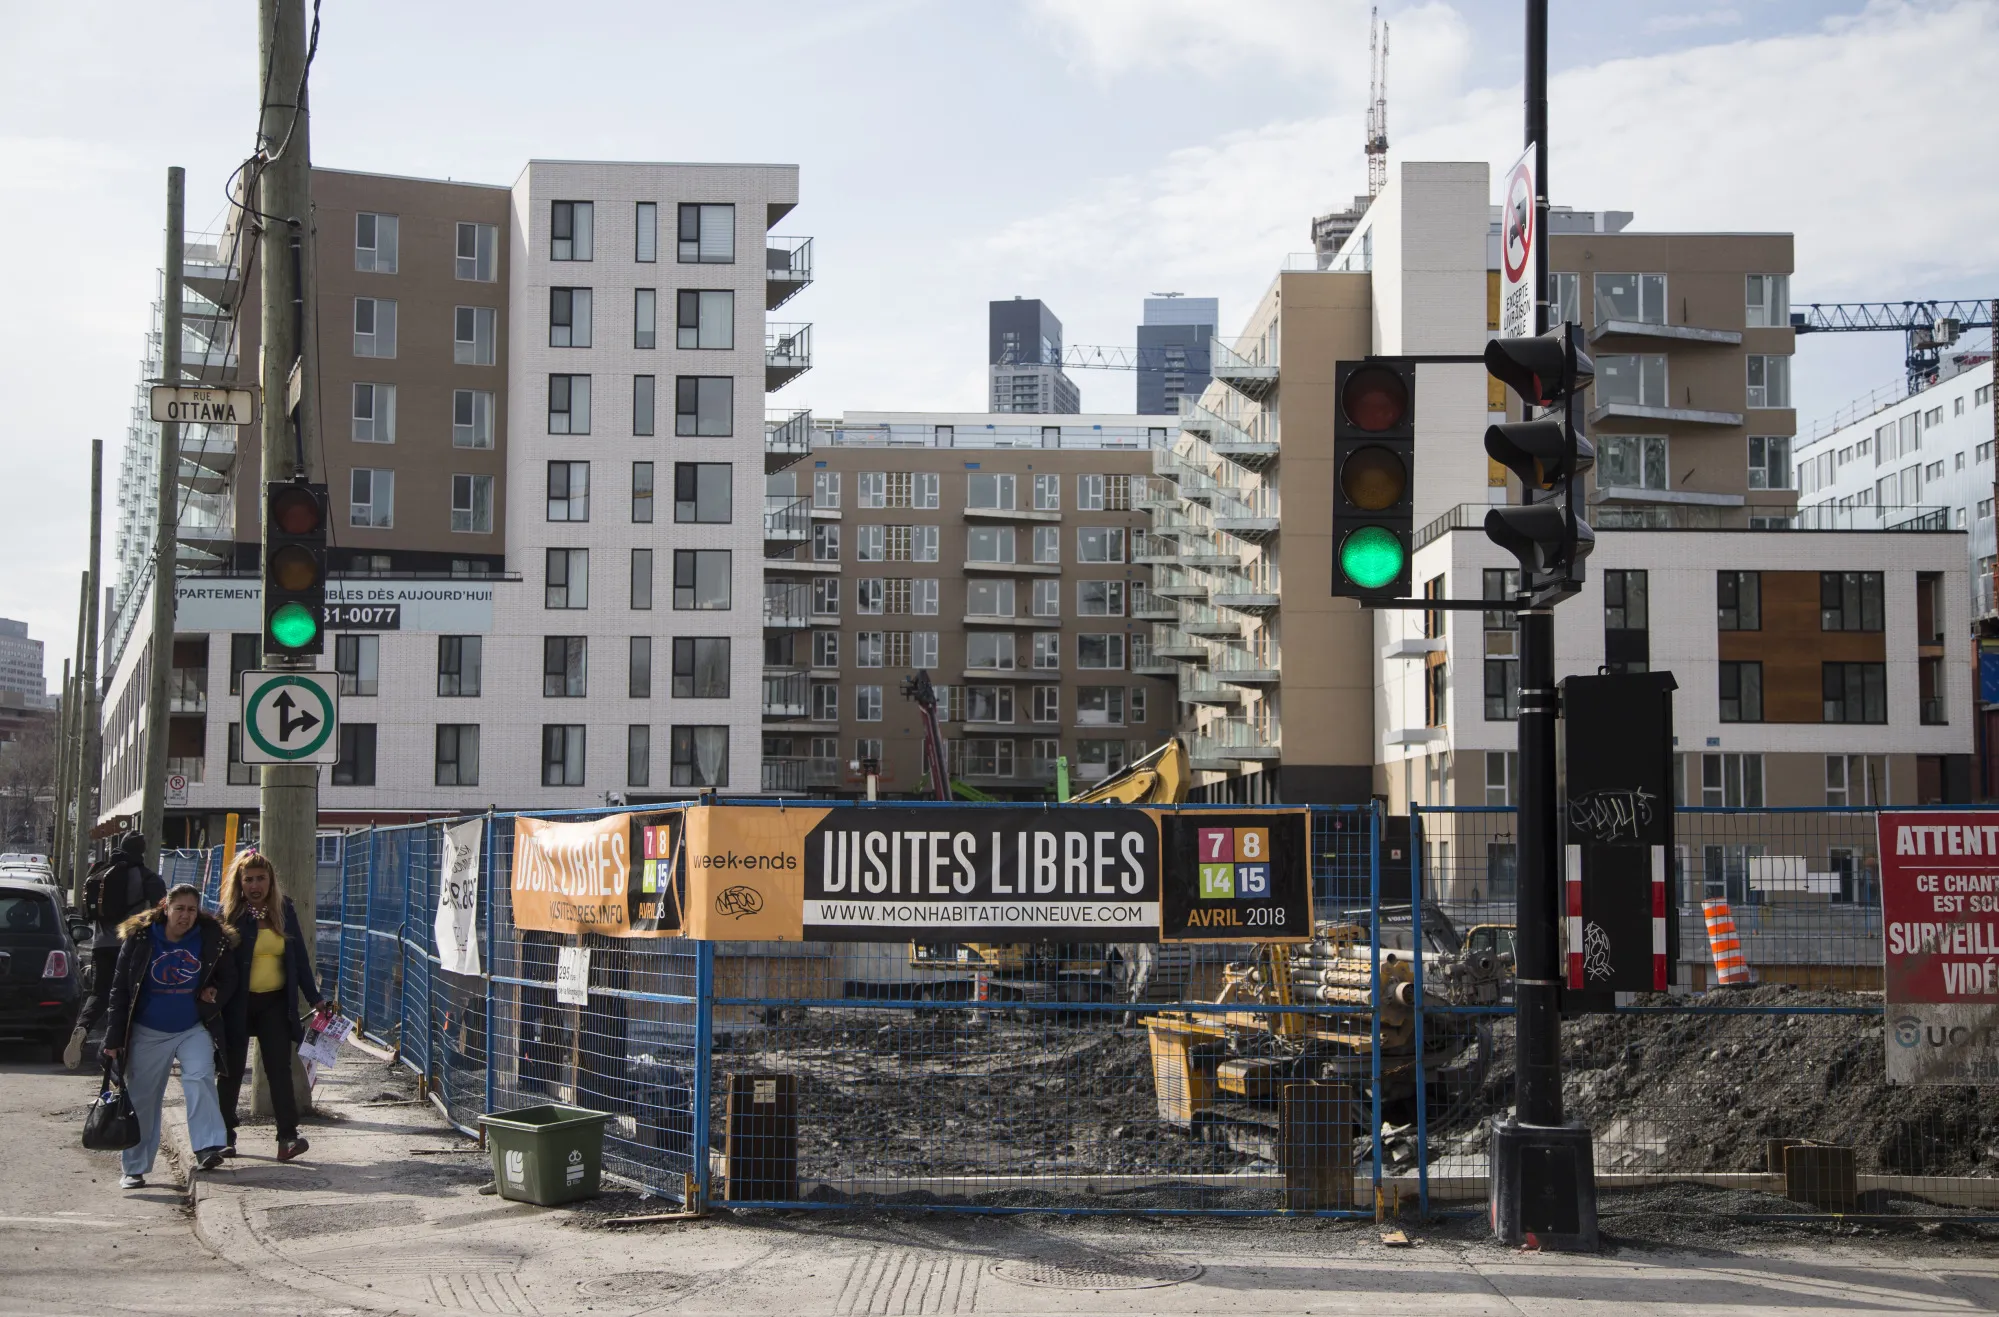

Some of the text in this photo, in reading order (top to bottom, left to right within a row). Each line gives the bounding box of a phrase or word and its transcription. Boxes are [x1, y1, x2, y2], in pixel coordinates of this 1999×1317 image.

[1504, 298, 1530, 331] LIVRAISON
[193, 391, 211, 401] RUE
[168, 401, 237, 422] OTTAWA
[175, 588, 262, 599] PARTEMENT
[325, 590, 364, 600] IBLES
[368, 588, 394, 600] DÈS
[647, 830, 667, 855] 7 8
[1208, 832, 1260, 858] 7 8
[1896, 825, 1999, 856] ATTENT
[823, 830, 1144, 894] VISITES LIBRES
[645, 863, 667, 888] 14 15
[1203, 867, 1265, 893] 14 15
[1916, 875, 1939, 892] CE
[638, 902, 657, 919] AVRIL
[821, 904, 1142, 922] WWW.MONHABITATIONNEUVE.COM
[1933, 895, 1964, 913] EST
[1187, 907, 1285, 926] AVRIL 2018
[1942, 957, 1999, 995] VIDÉ
